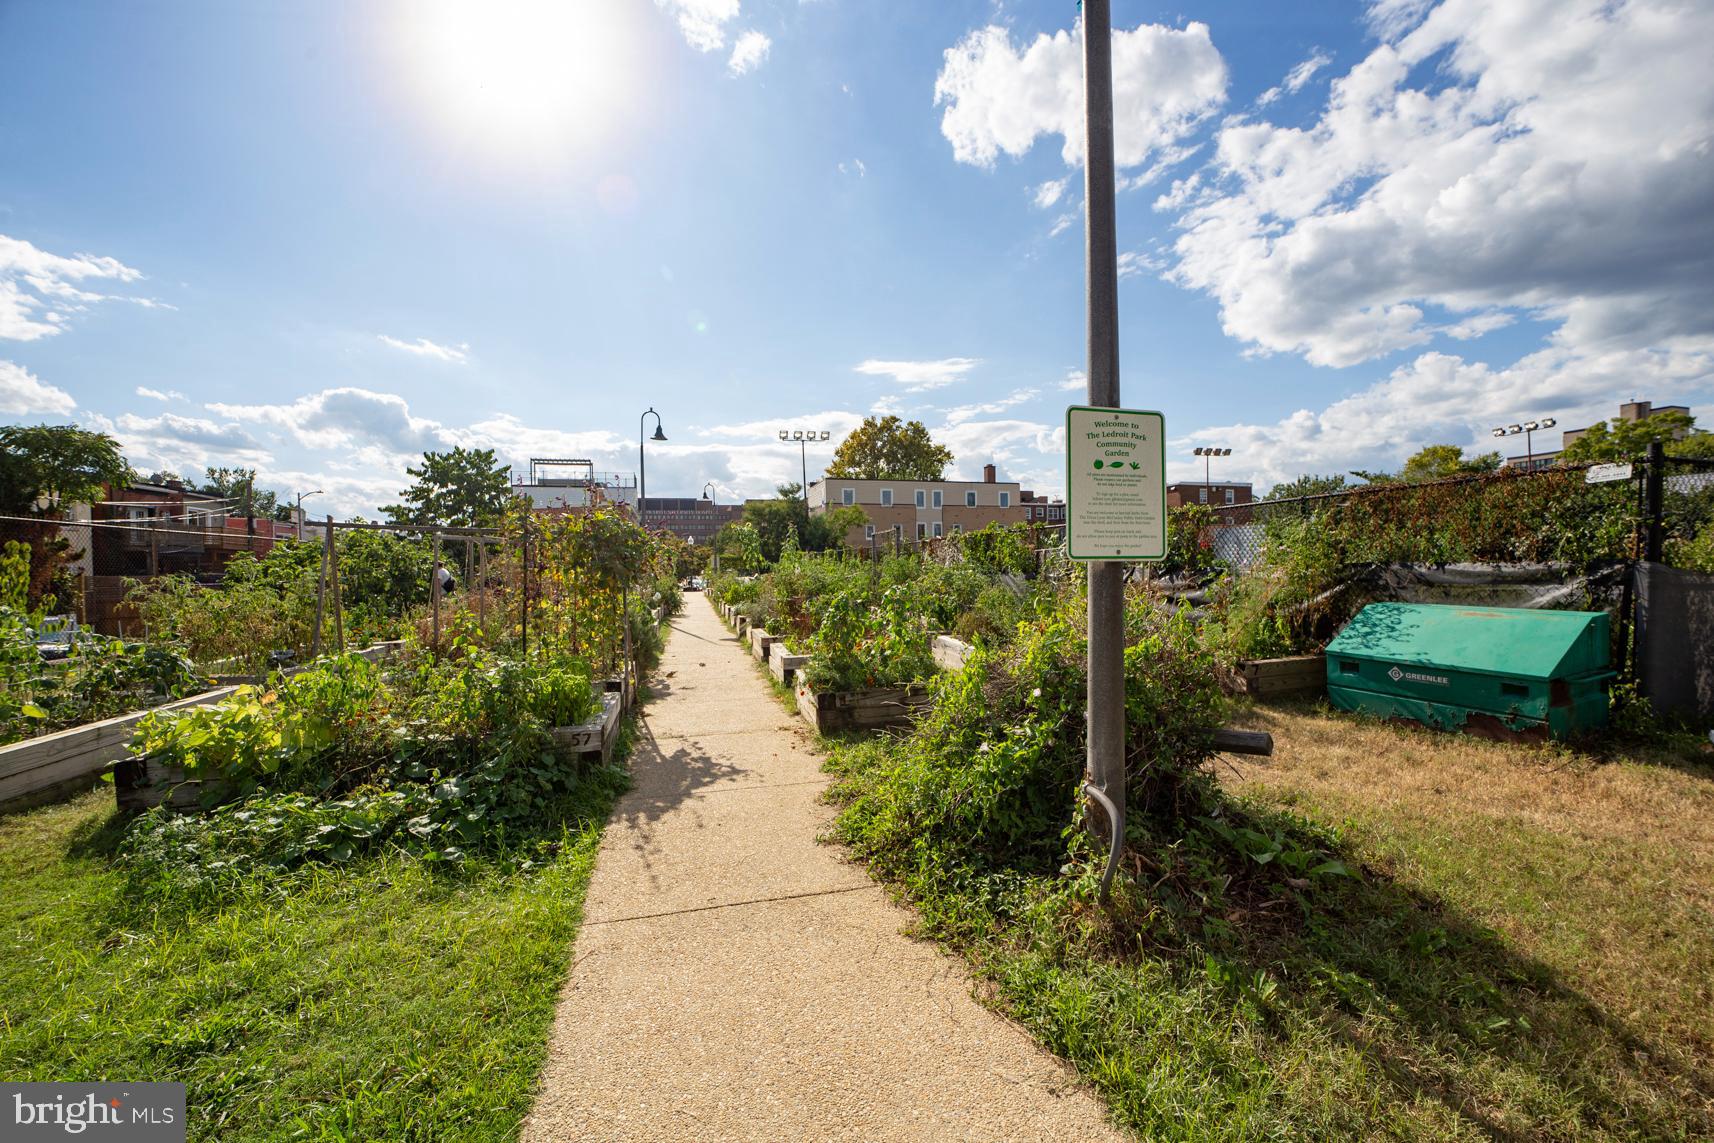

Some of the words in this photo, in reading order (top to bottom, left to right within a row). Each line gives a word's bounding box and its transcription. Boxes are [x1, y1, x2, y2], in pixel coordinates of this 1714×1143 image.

[1094, 420, 1129, 428] Welcome
[1102, 430, 1129, 438] Ledroit
[1131, 432, 1147, 441] Park
[1096, 441, 1137, 450] Community
[1405, 672, 1449, 684] GREENLEE
[572, 733, 592, 746] 57
